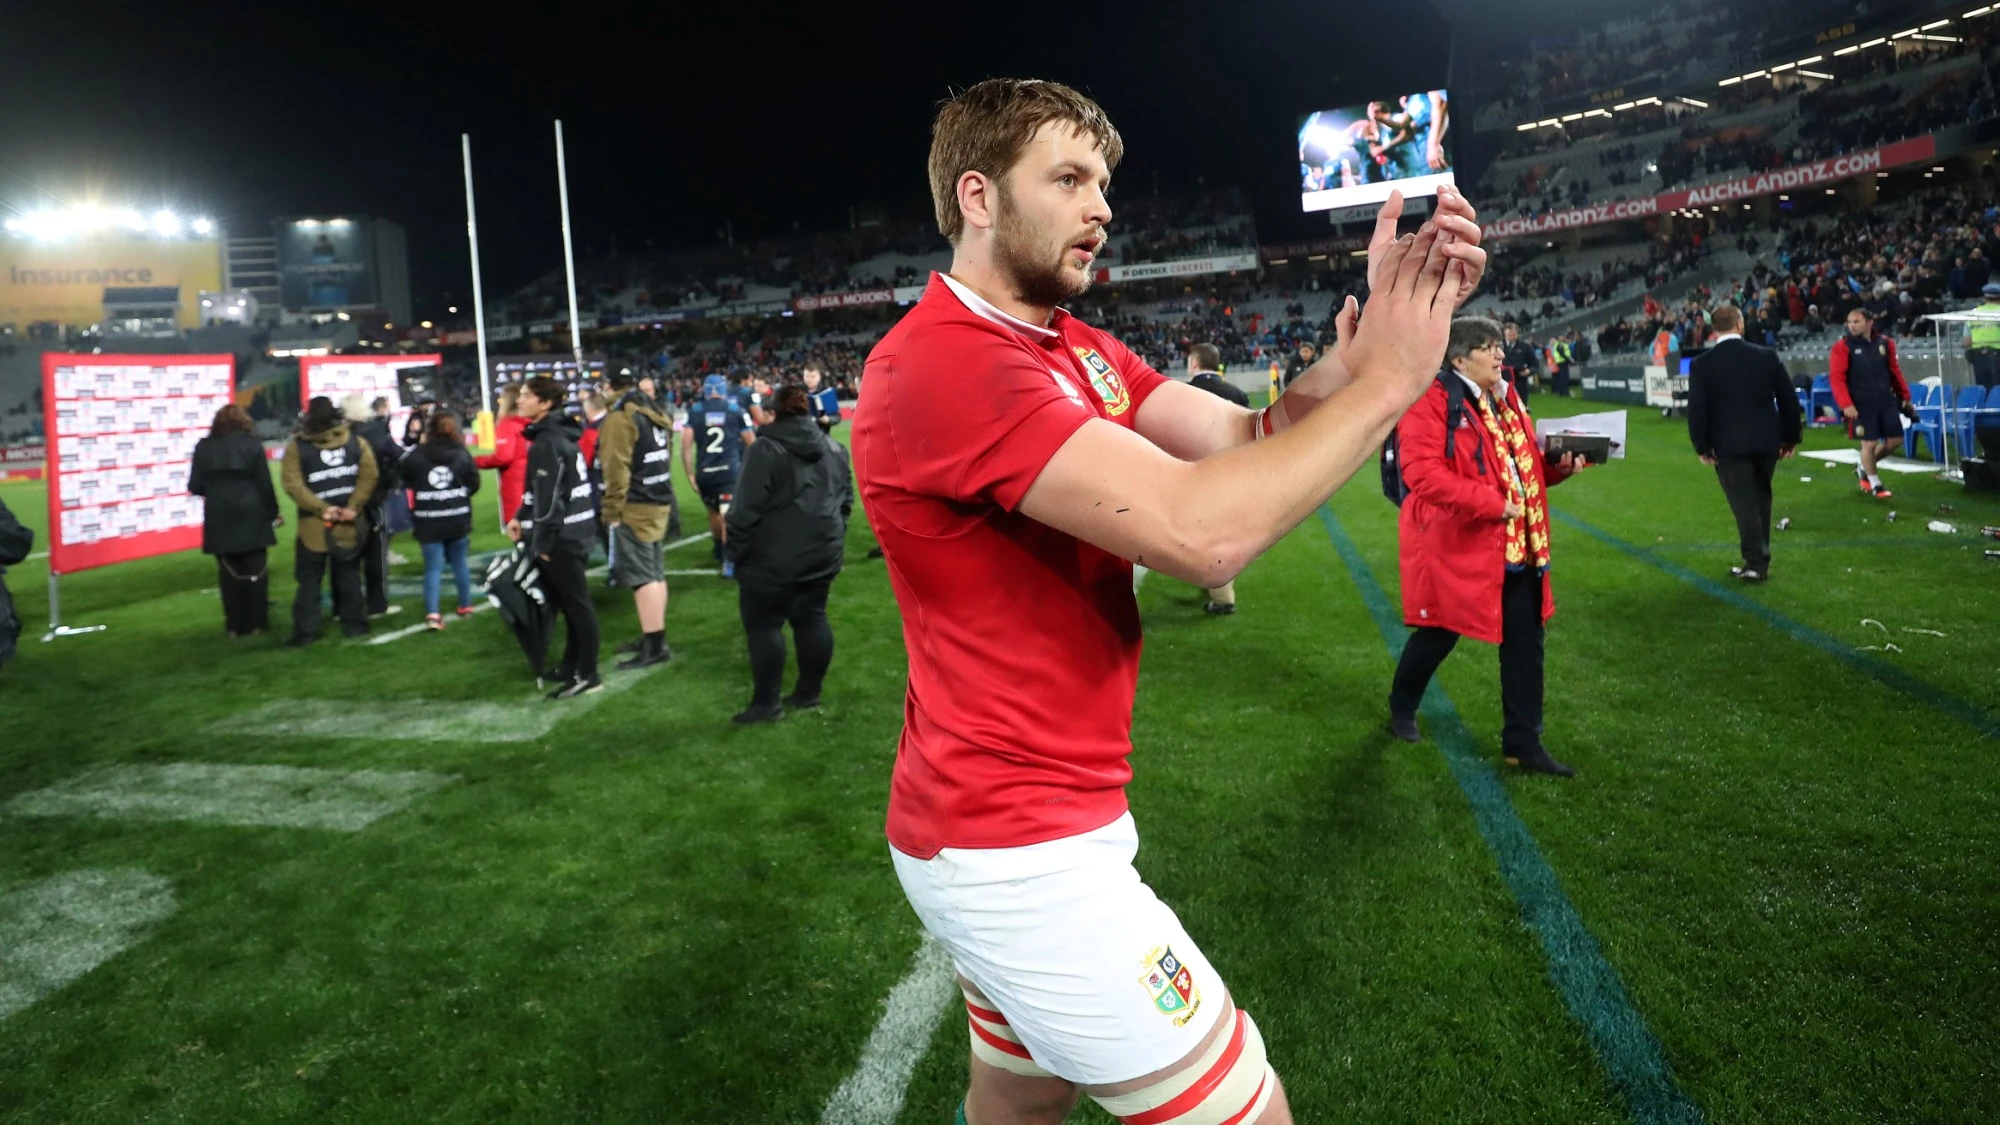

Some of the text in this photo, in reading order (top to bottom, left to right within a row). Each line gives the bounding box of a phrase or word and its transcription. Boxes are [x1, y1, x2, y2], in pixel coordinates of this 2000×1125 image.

[1687, 151, 1881, 206] AUCKLANDNZ.COM
[1483, 197, 1657, 239] AUCKLANDNZ.COM
[9, 264, 153, 284] Insurance
[1132, 266, 1168, 277] DRYMIX
[1171, 262, 1215, 274] CONCRETE
[820, 295, 840, 308] KIA
[843, 290, 892, 305] MOTORS
[706, 426, 725, 453] 2
